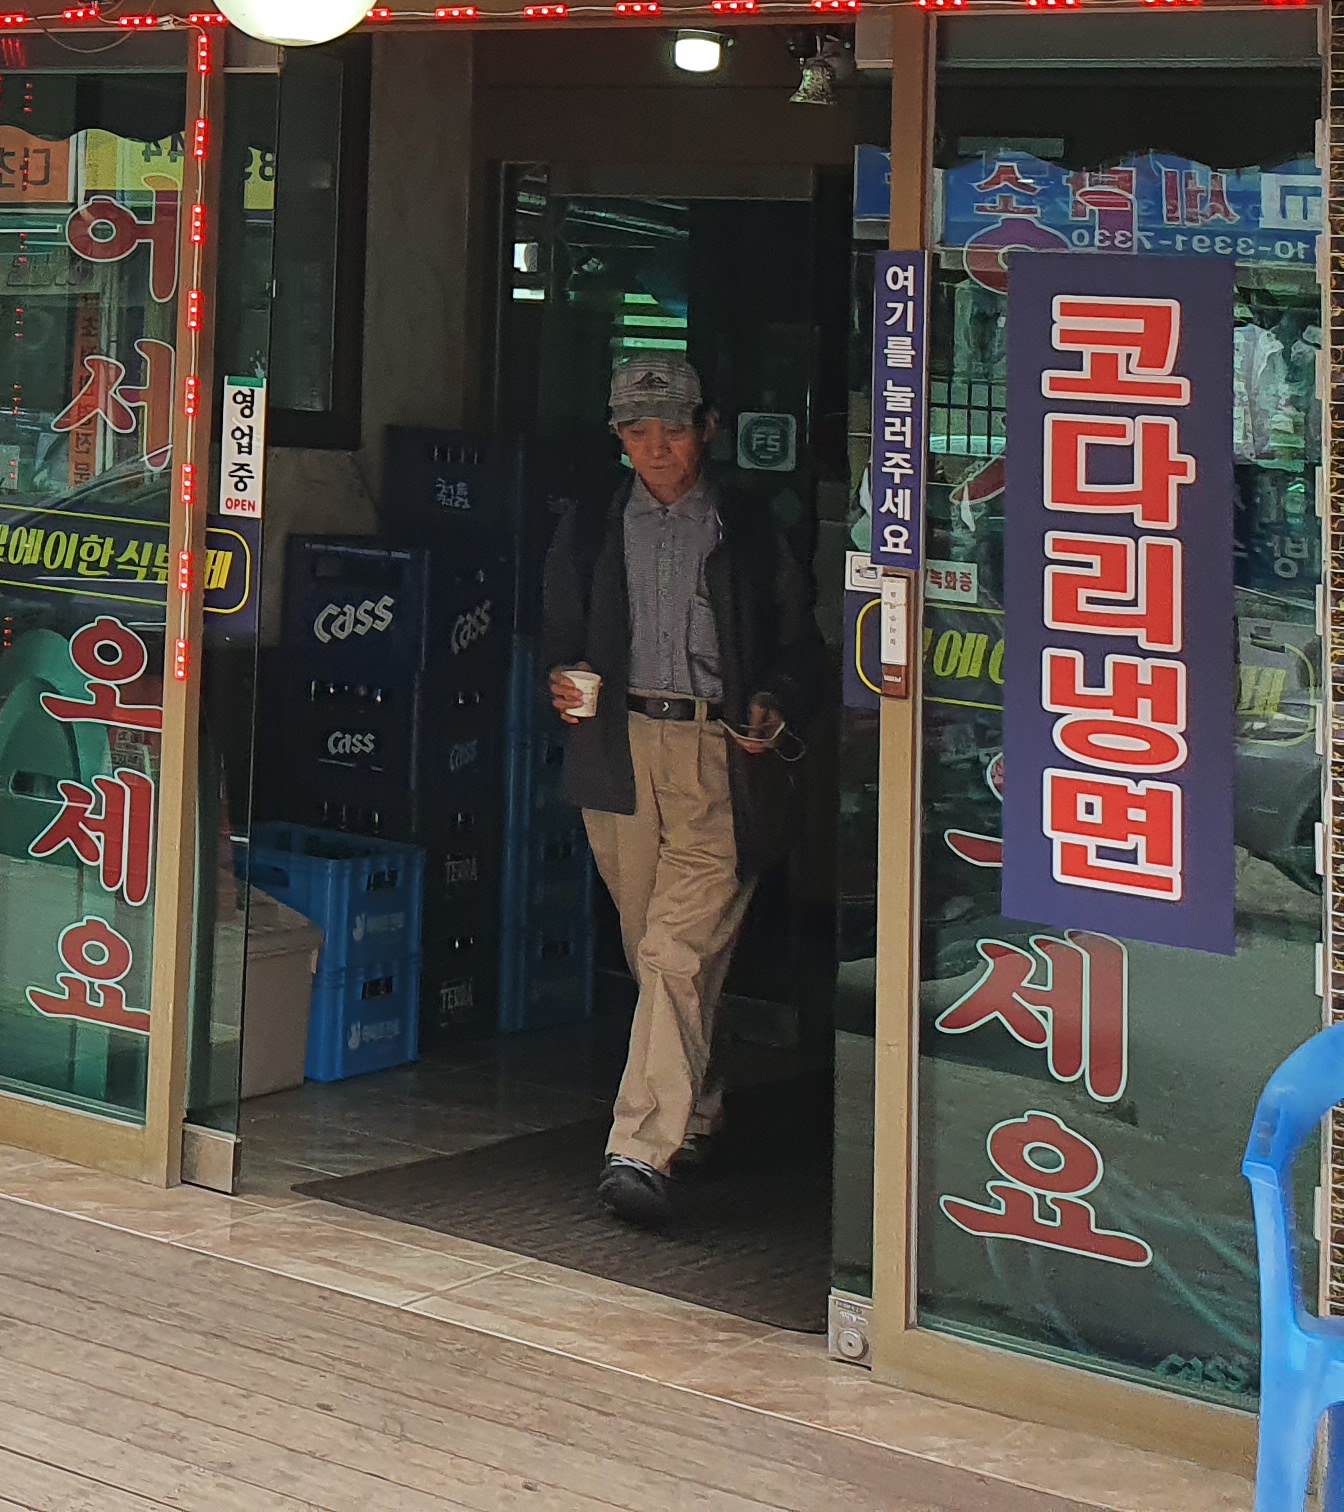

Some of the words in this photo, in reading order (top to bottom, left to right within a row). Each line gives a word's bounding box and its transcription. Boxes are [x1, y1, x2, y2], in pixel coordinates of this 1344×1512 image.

[882, 262, 916, 368] 여기를
[225, 497, 256, 513] OPEN
[229, 388, 256, 493] 영업중
[878, 379, 916, 556] 눌러주세요
[1039, 292, 1198, 902] 코다리냉면
[933, 750, 1154, 1268] 세요
